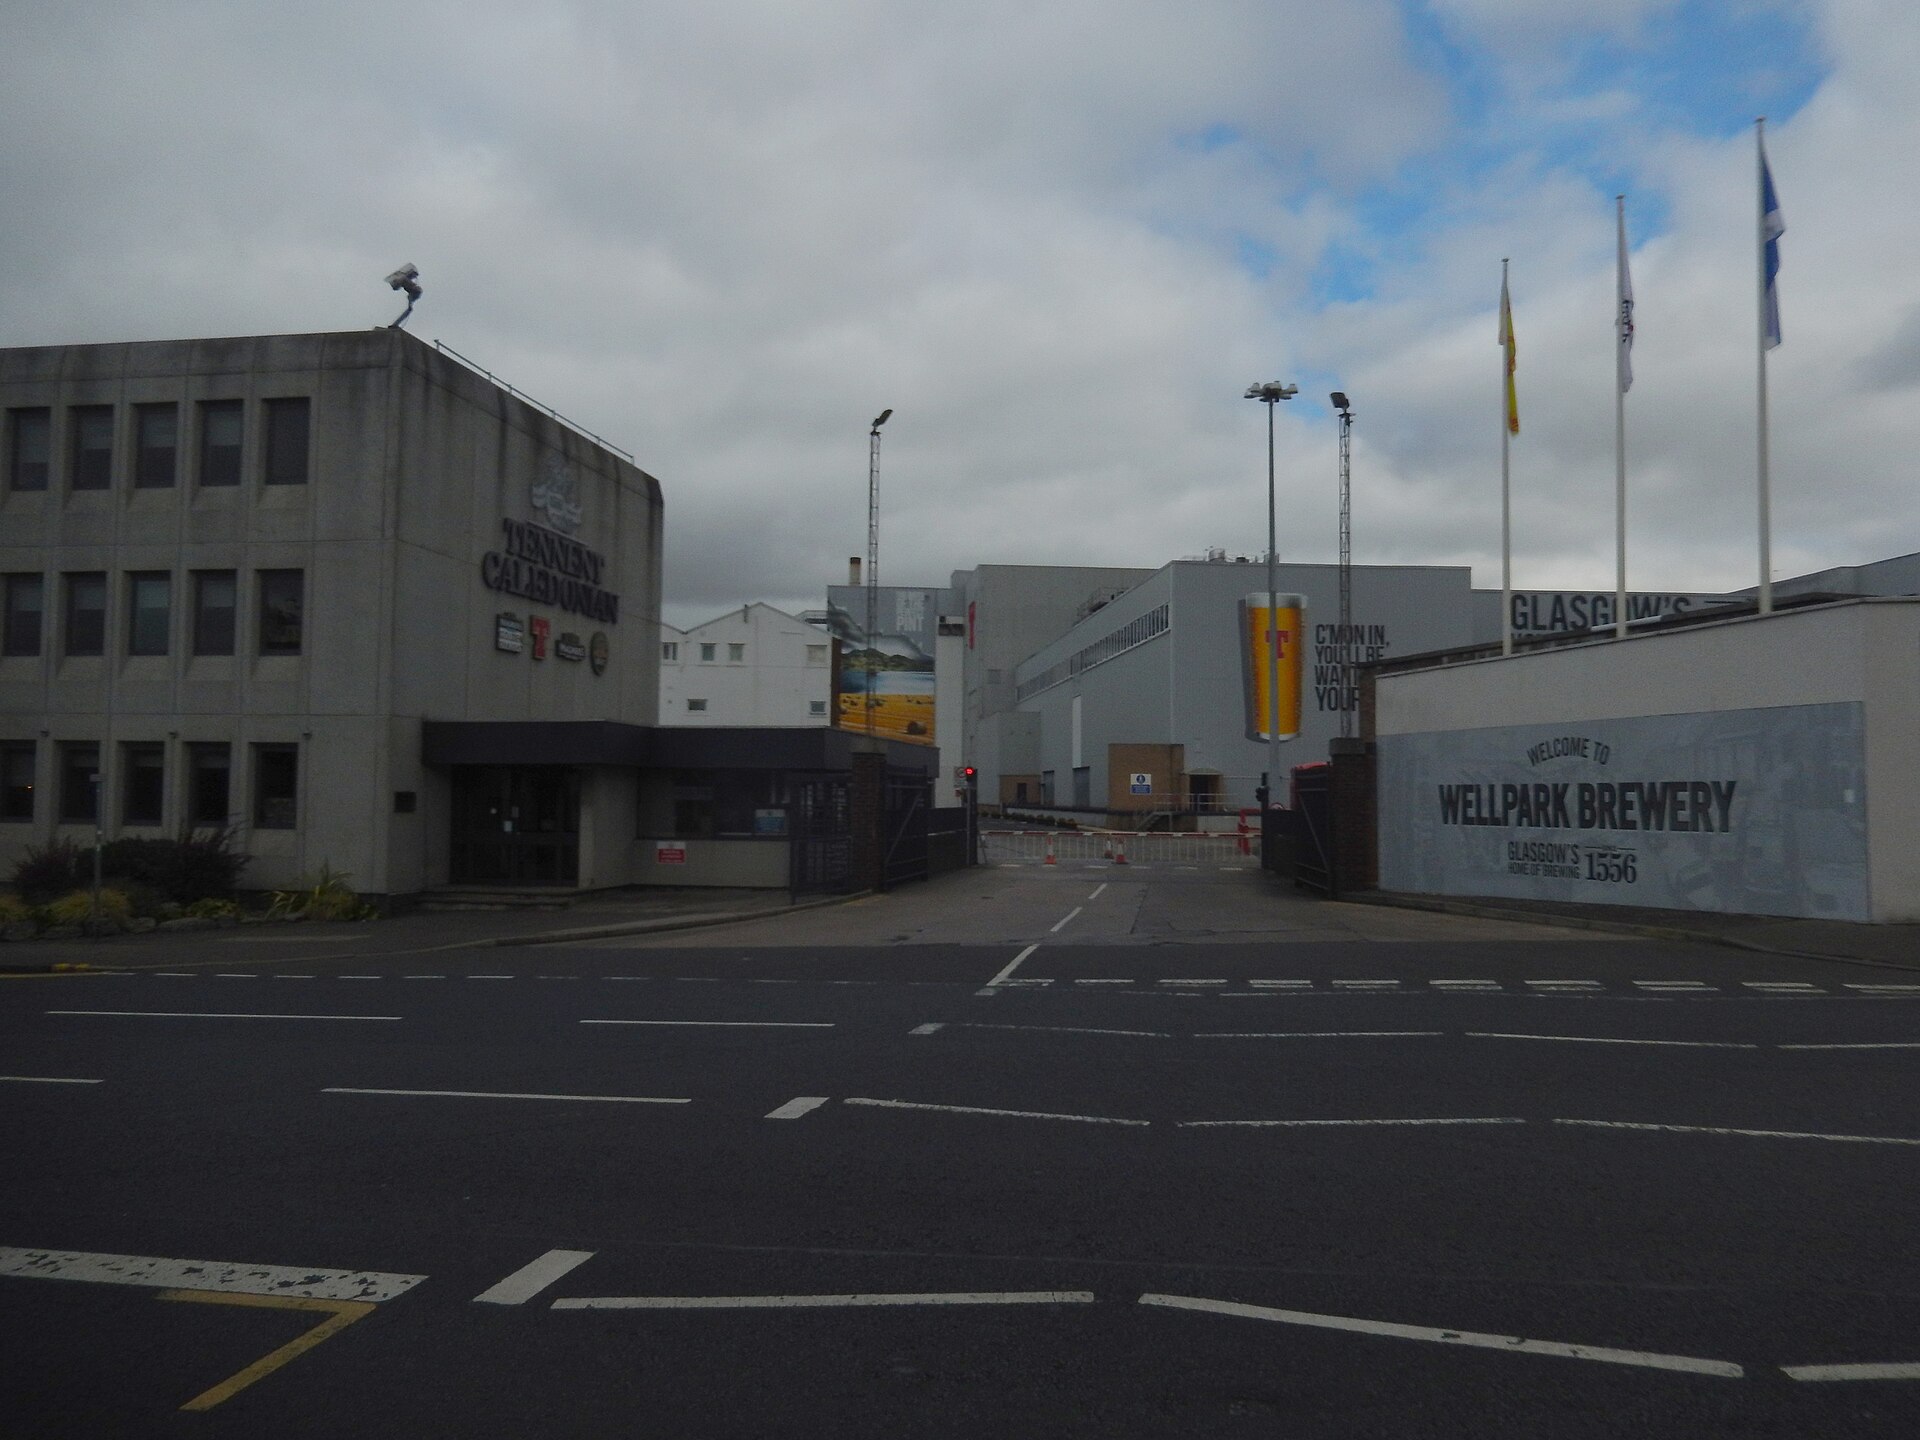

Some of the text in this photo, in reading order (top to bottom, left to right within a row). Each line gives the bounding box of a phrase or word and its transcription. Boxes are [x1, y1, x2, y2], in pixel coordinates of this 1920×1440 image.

[482, 551, 620, 625] CALEDONIAN
[1315, 624, 1364, 645] C'MON
[1366, 646, 1384, 662] BE
[1527, 736, 1610, 766] WELCOME TO
[1438, 781, 1737, 832] WELLPARK BREWERY
[1508, 841, 1580, 864] GLASGOW'S
[1544, 864, 1580, 879] BREWING
[1585, 852, 1637, 884] 1556
